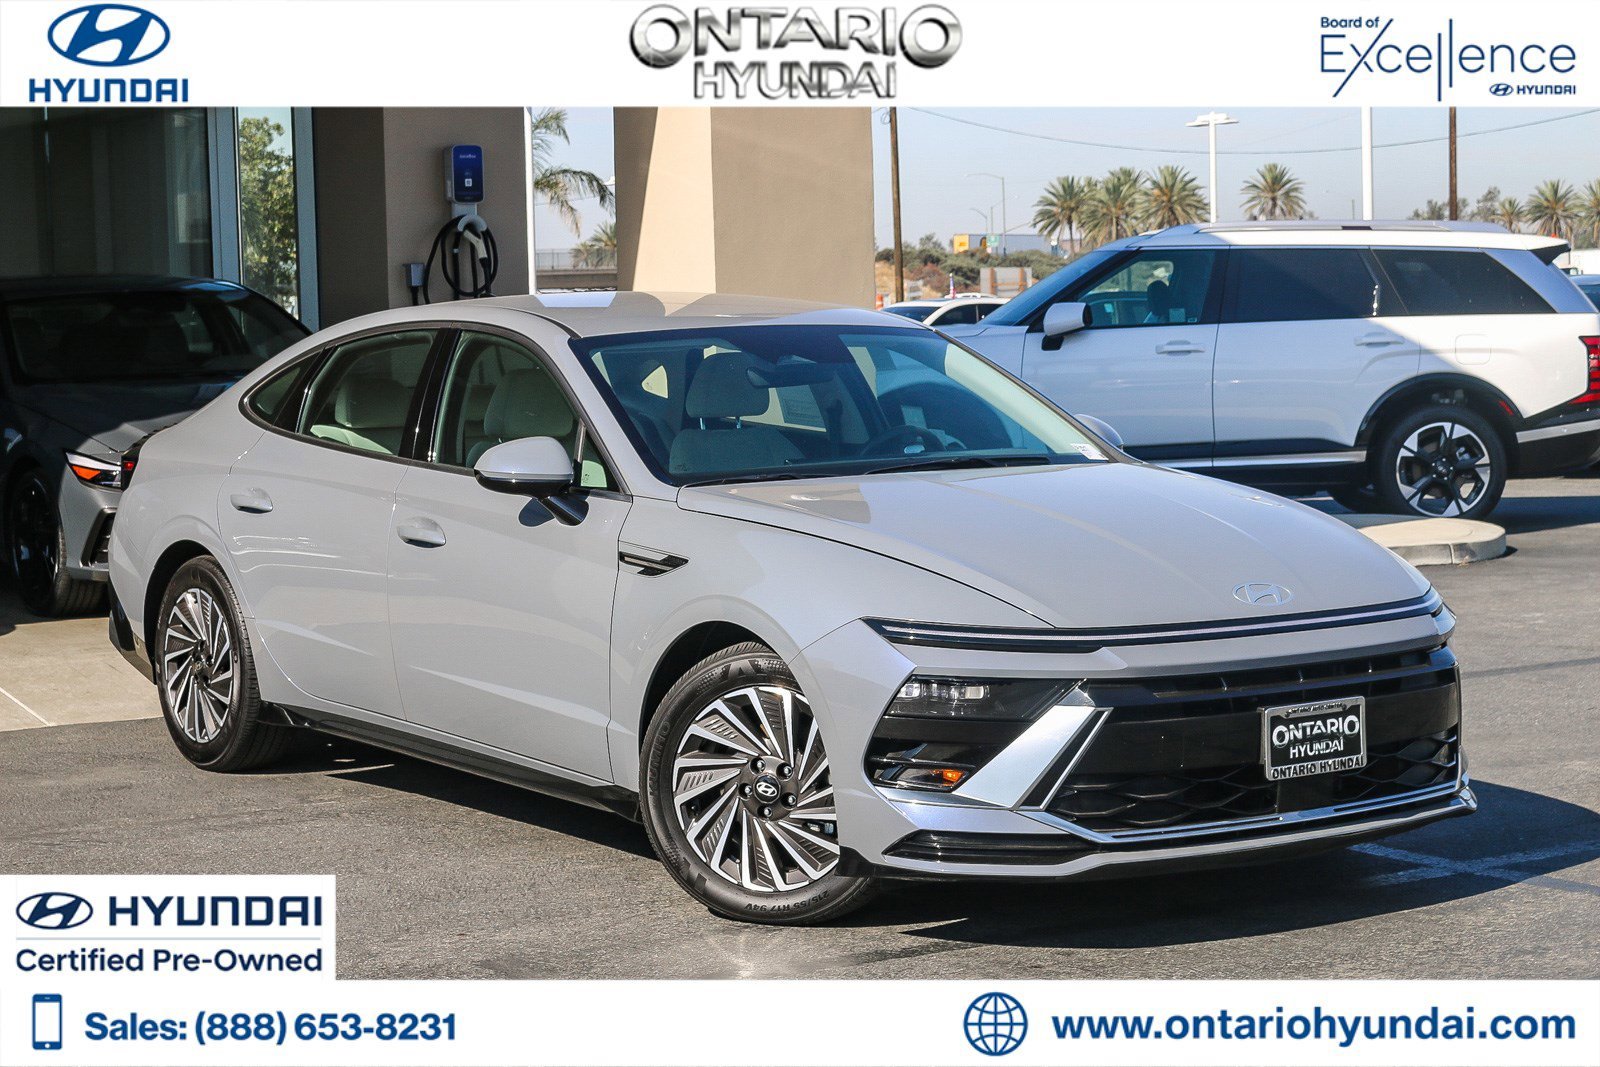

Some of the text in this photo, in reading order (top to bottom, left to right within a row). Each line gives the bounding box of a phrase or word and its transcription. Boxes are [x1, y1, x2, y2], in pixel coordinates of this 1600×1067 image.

[1272, 715, 1360, 747] ONTARIO
[1289, 736, 1344, 759] HYUNDAI
[1272, 755, 1364, 779] ONTARIO HYUNDAI
[744, 890, 830, 912] 215/55 R17 94V
